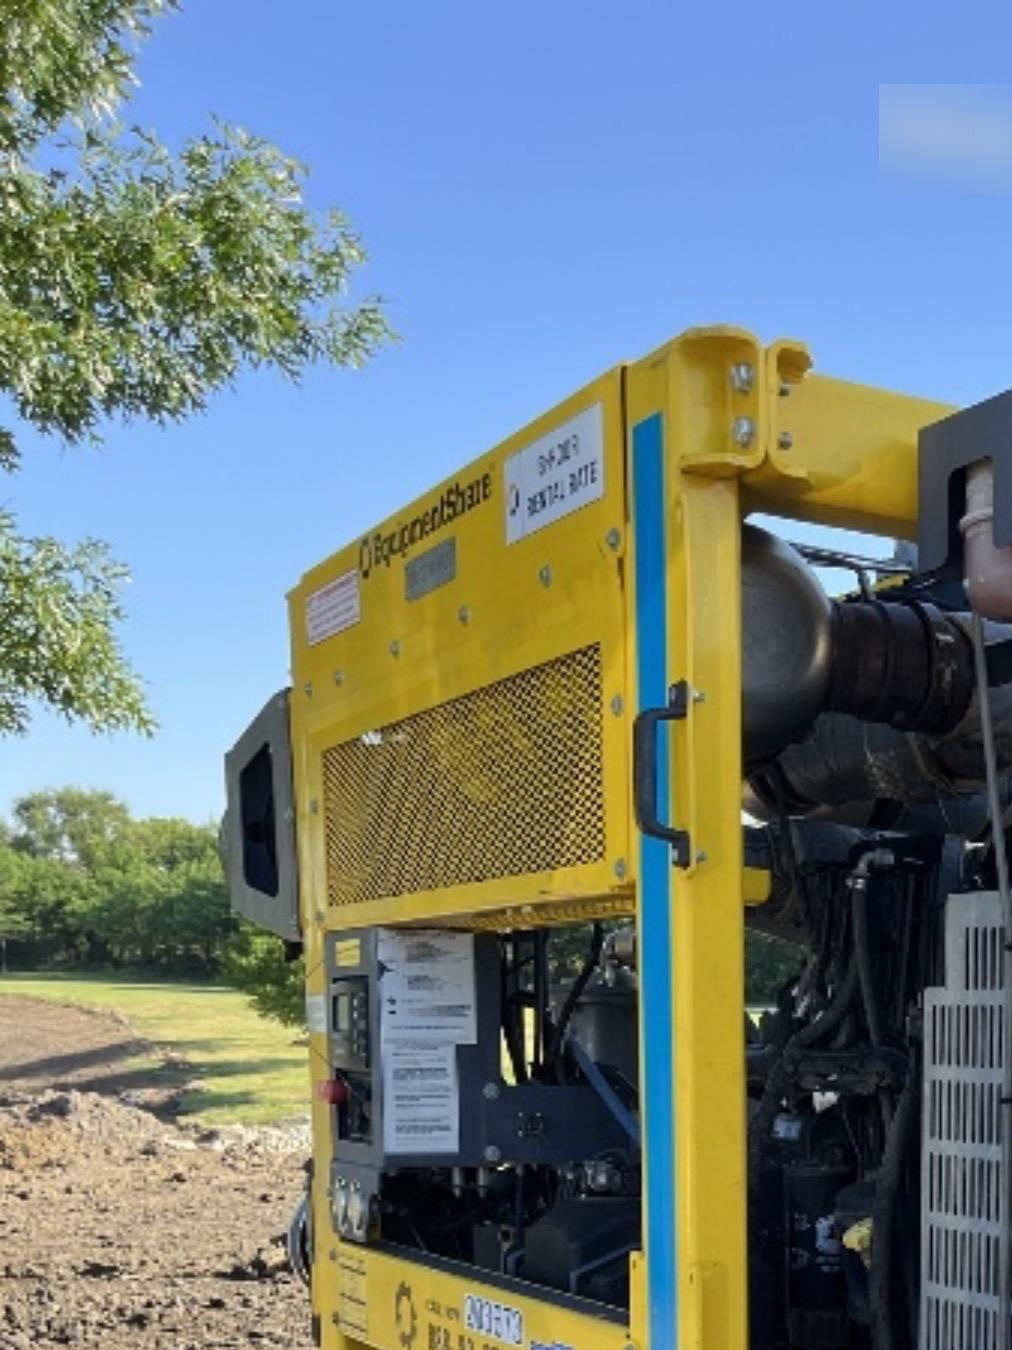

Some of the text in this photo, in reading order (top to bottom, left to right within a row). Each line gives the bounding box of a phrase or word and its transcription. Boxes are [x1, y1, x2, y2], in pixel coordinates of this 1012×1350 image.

[373, 472, 492, 568] EquipmentShare
[526, 458, 598, 517] RENTAL RATE
